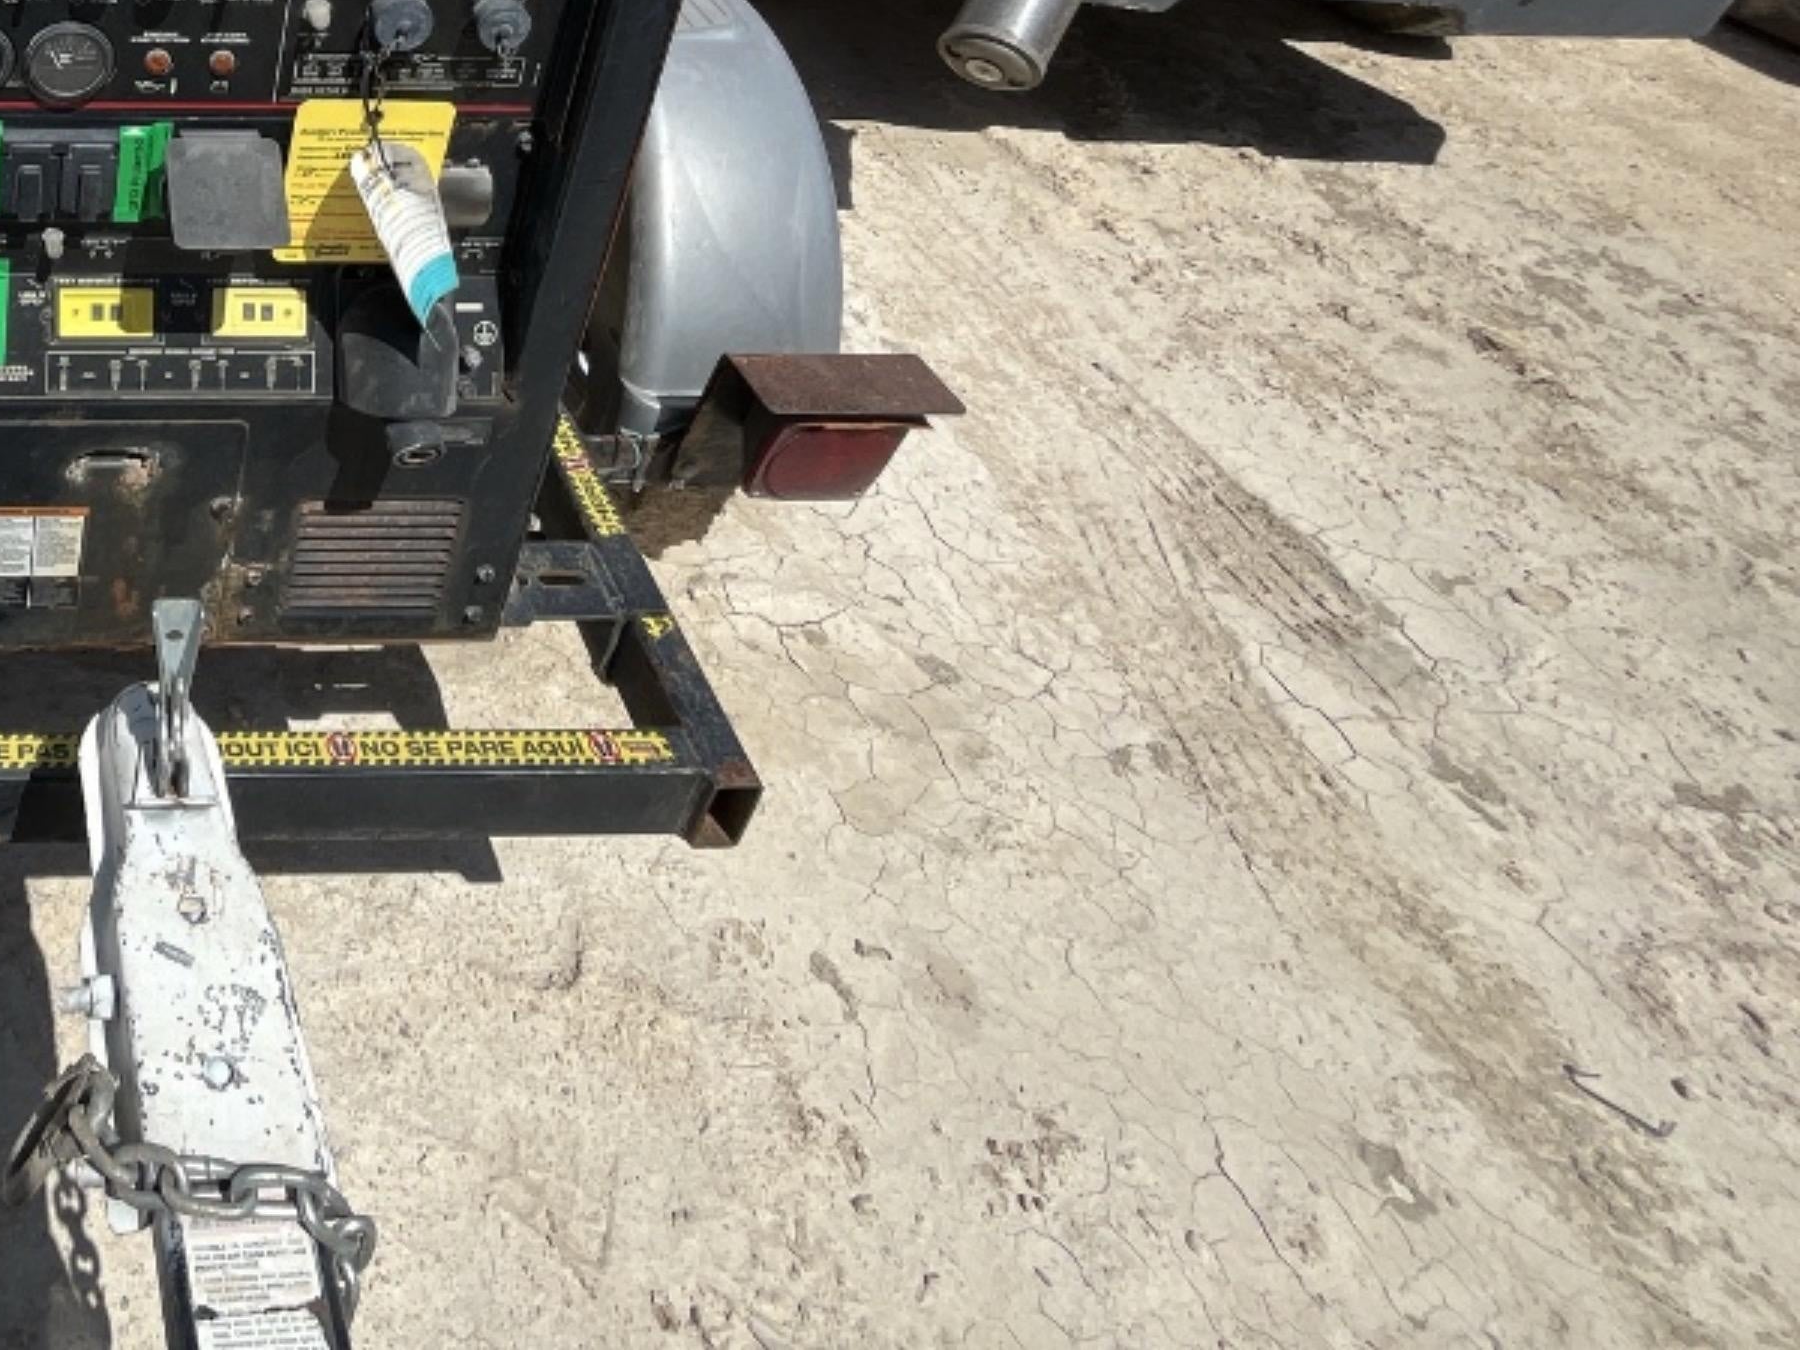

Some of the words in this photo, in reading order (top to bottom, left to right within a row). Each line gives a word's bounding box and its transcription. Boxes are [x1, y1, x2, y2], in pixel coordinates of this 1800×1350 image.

[17, 743, 70, 760] PAS
[285, 741, 320, 757] ICI
[360, 741, 399, 757] NO
[405, 741, 441, 757] SE
[446, 741, 514, 757] PARE
